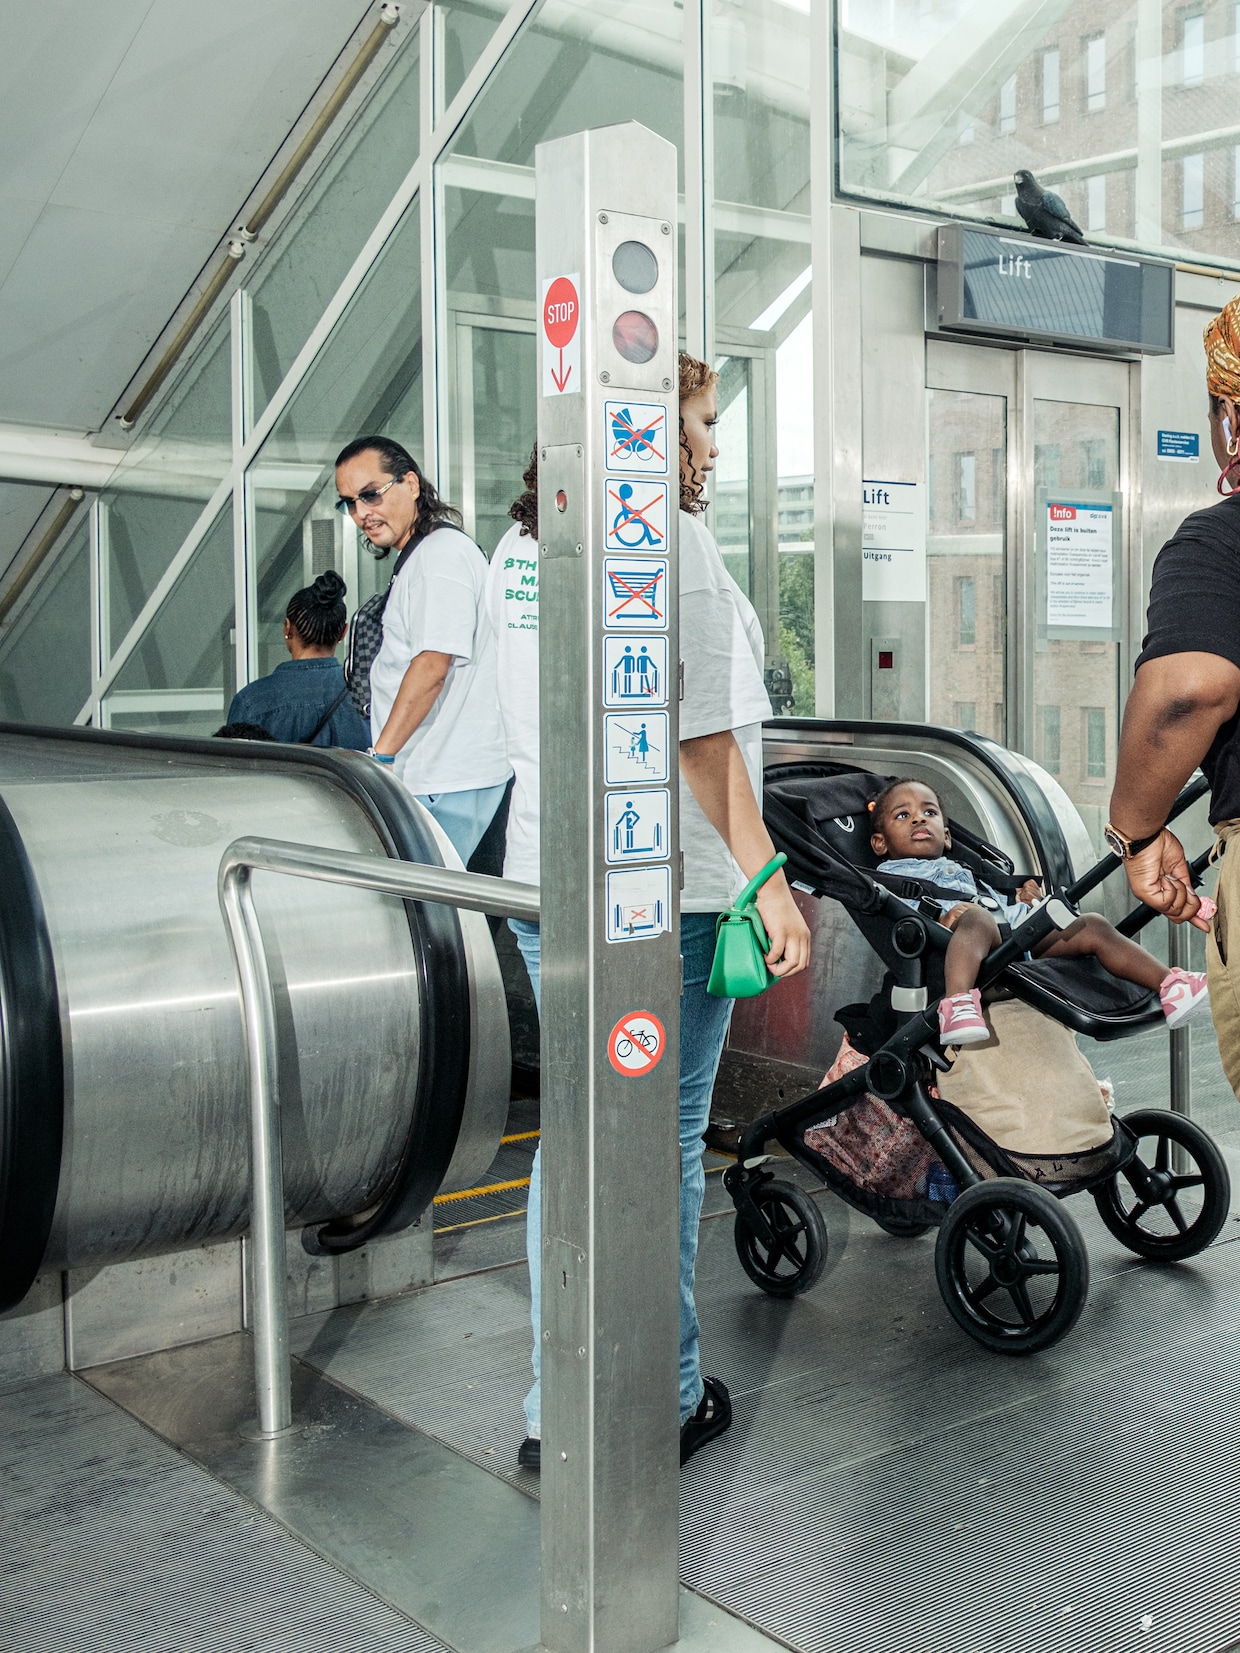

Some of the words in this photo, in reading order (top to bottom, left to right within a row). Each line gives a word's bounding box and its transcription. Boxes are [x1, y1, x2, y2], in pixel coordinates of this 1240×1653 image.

[999, 254, 1031, 279] Lift
[547, 301, 575, 324] STOP
[863, 488, 890, 505] Lift
[863, 522, 887, 531] Perron
[863, 552, 892, 562] Uitgang
[521, 575, 540, 587] M
